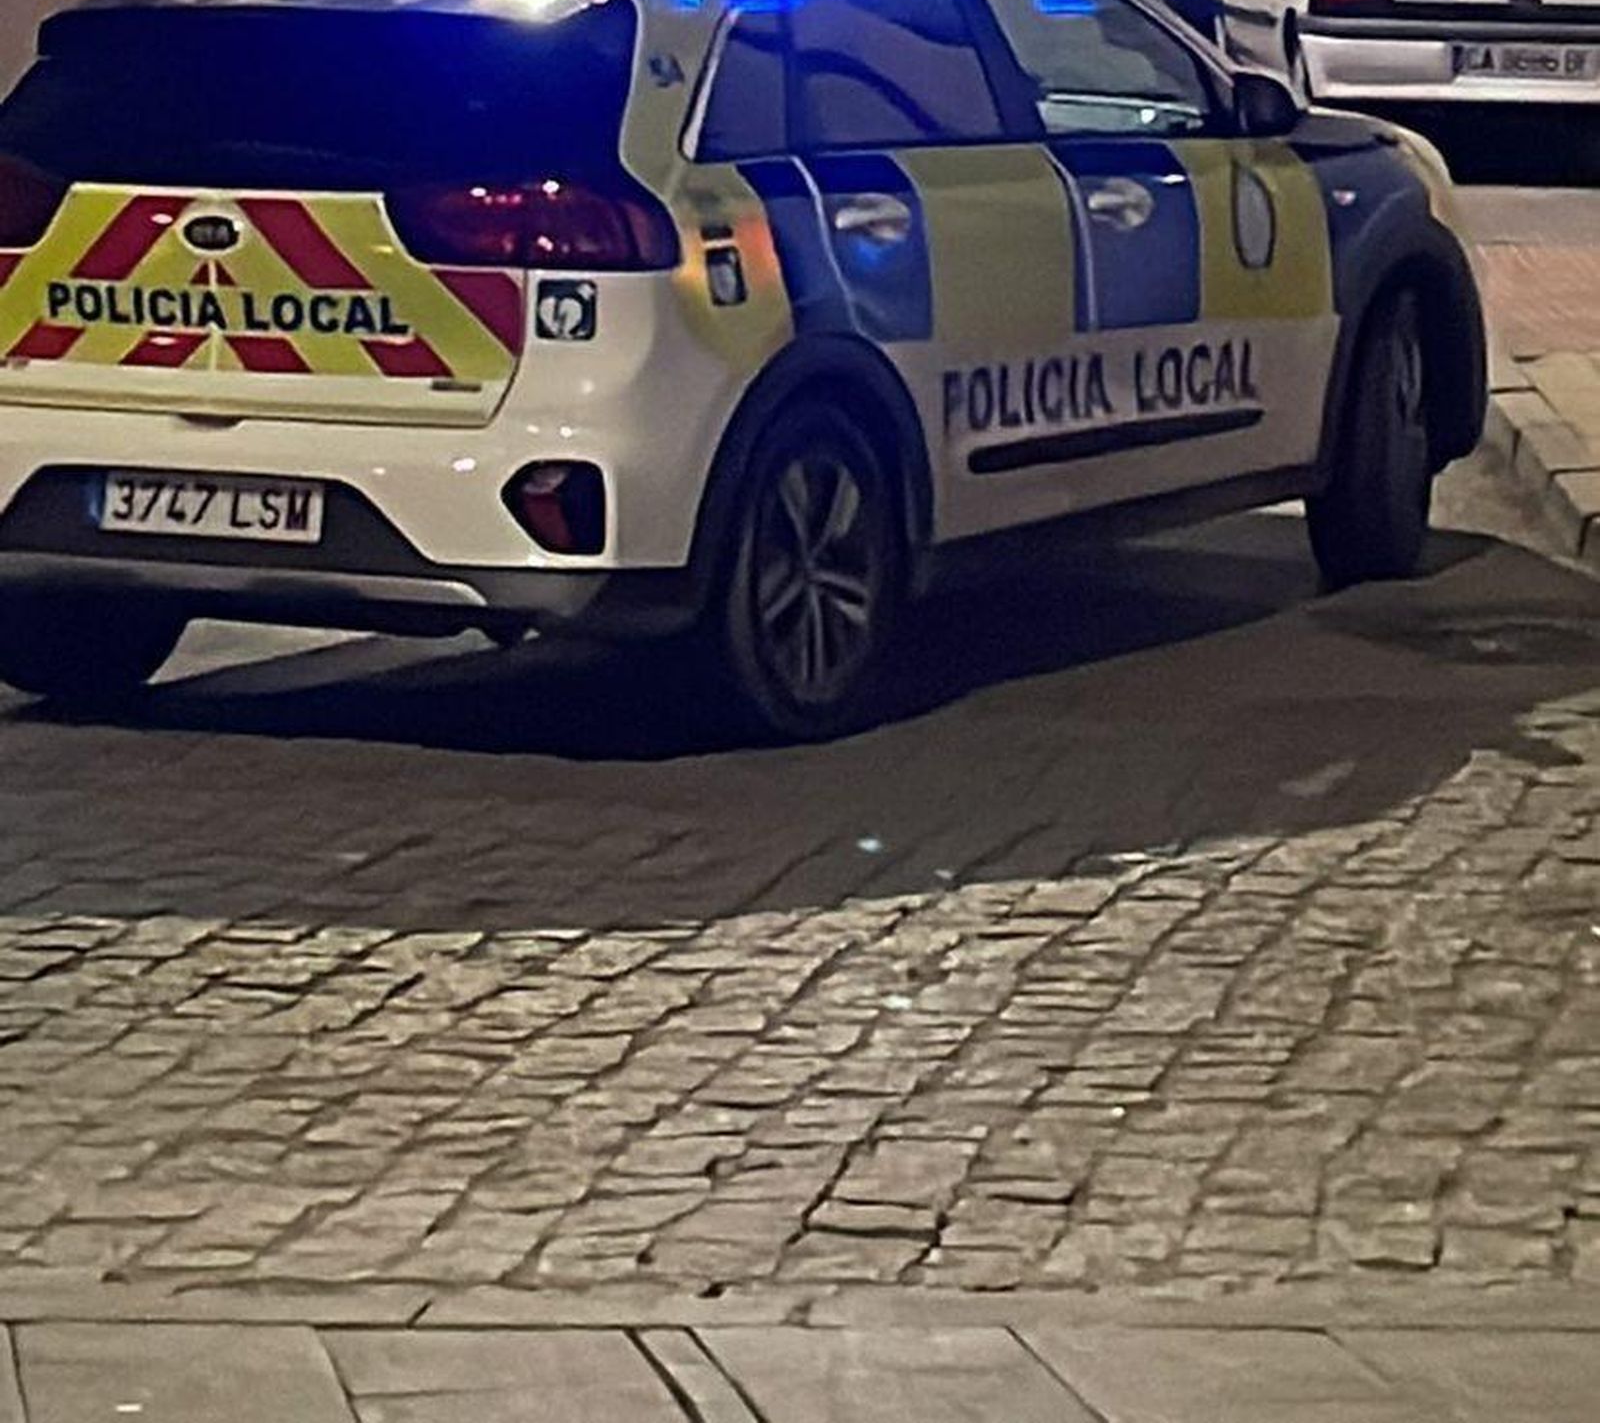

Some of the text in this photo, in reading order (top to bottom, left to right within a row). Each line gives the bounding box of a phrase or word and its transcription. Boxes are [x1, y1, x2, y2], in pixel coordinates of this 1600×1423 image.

[48, 281, 410, 334] POLICIA LOCAL
[942, 338, 1257, 434] POLICIA LOCAL
[113, 479, 218, 524] 3747
